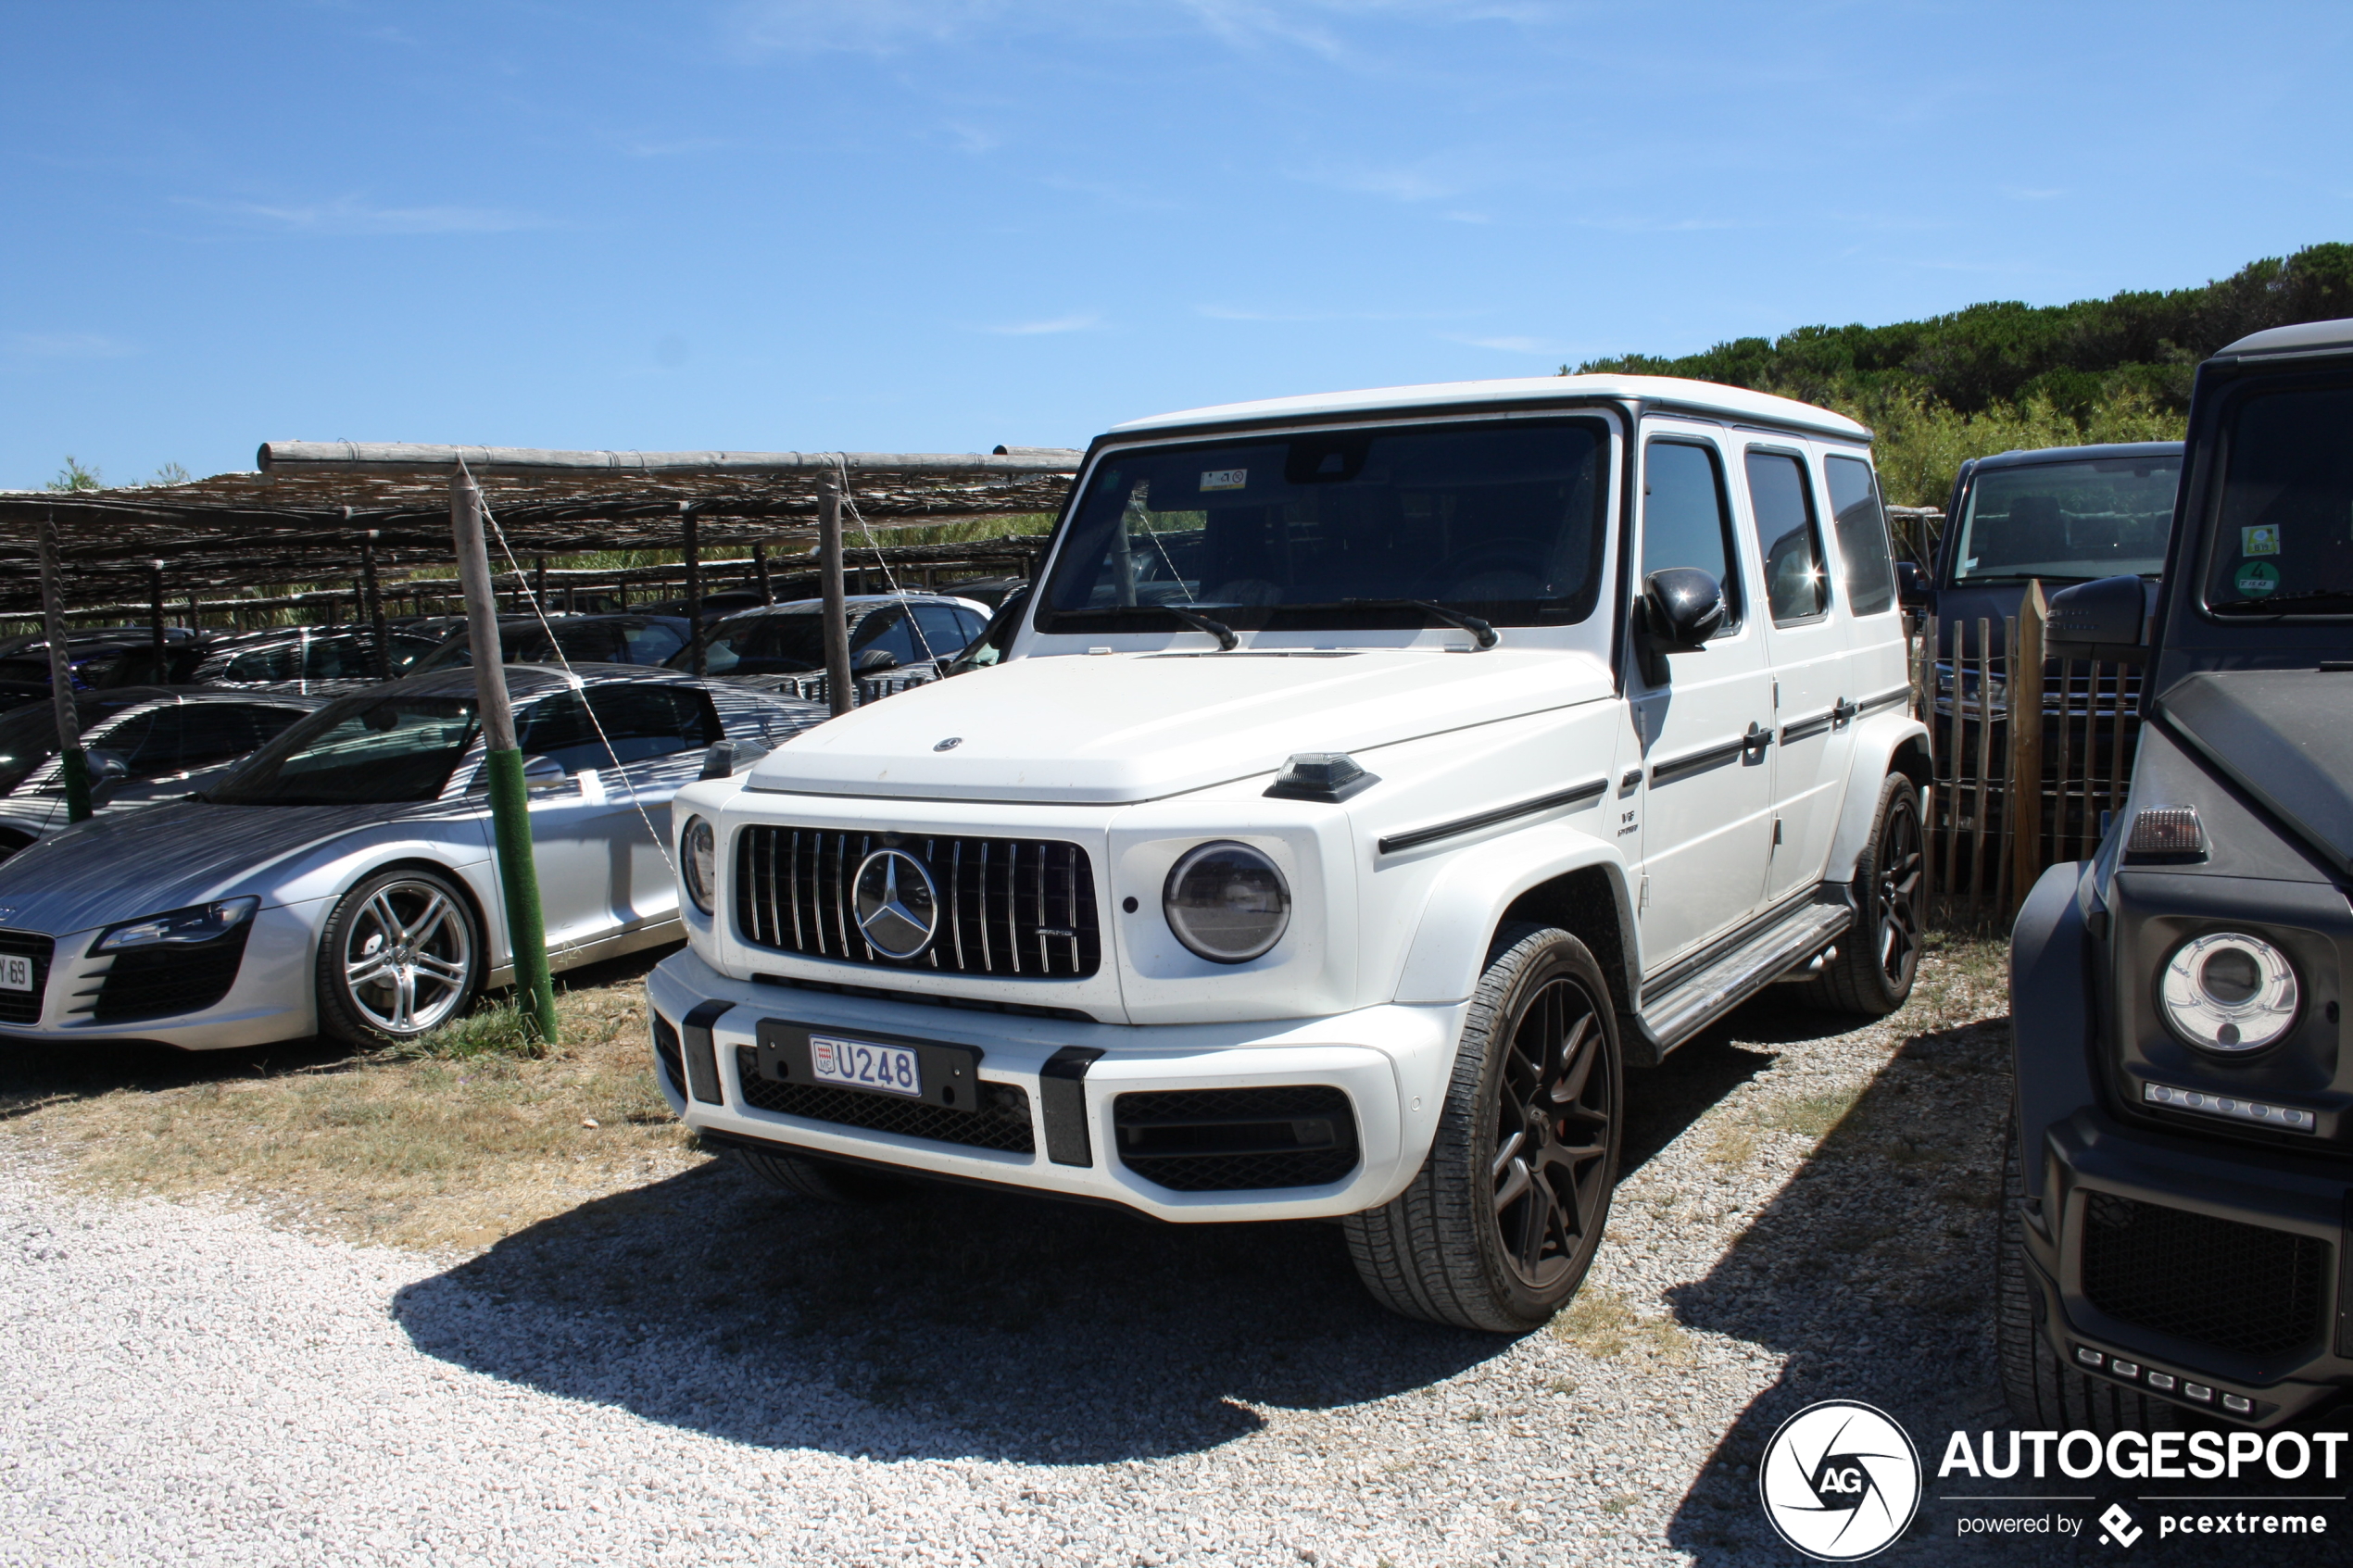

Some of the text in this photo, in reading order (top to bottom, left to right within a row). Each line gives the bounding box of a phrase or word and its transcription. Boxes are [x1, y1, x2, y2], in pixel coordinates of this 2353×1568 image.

[2251, 562, 2263, 580] 4
[10, 960, 25, 985] 69
[837, 1044, 912, 1088] U248
